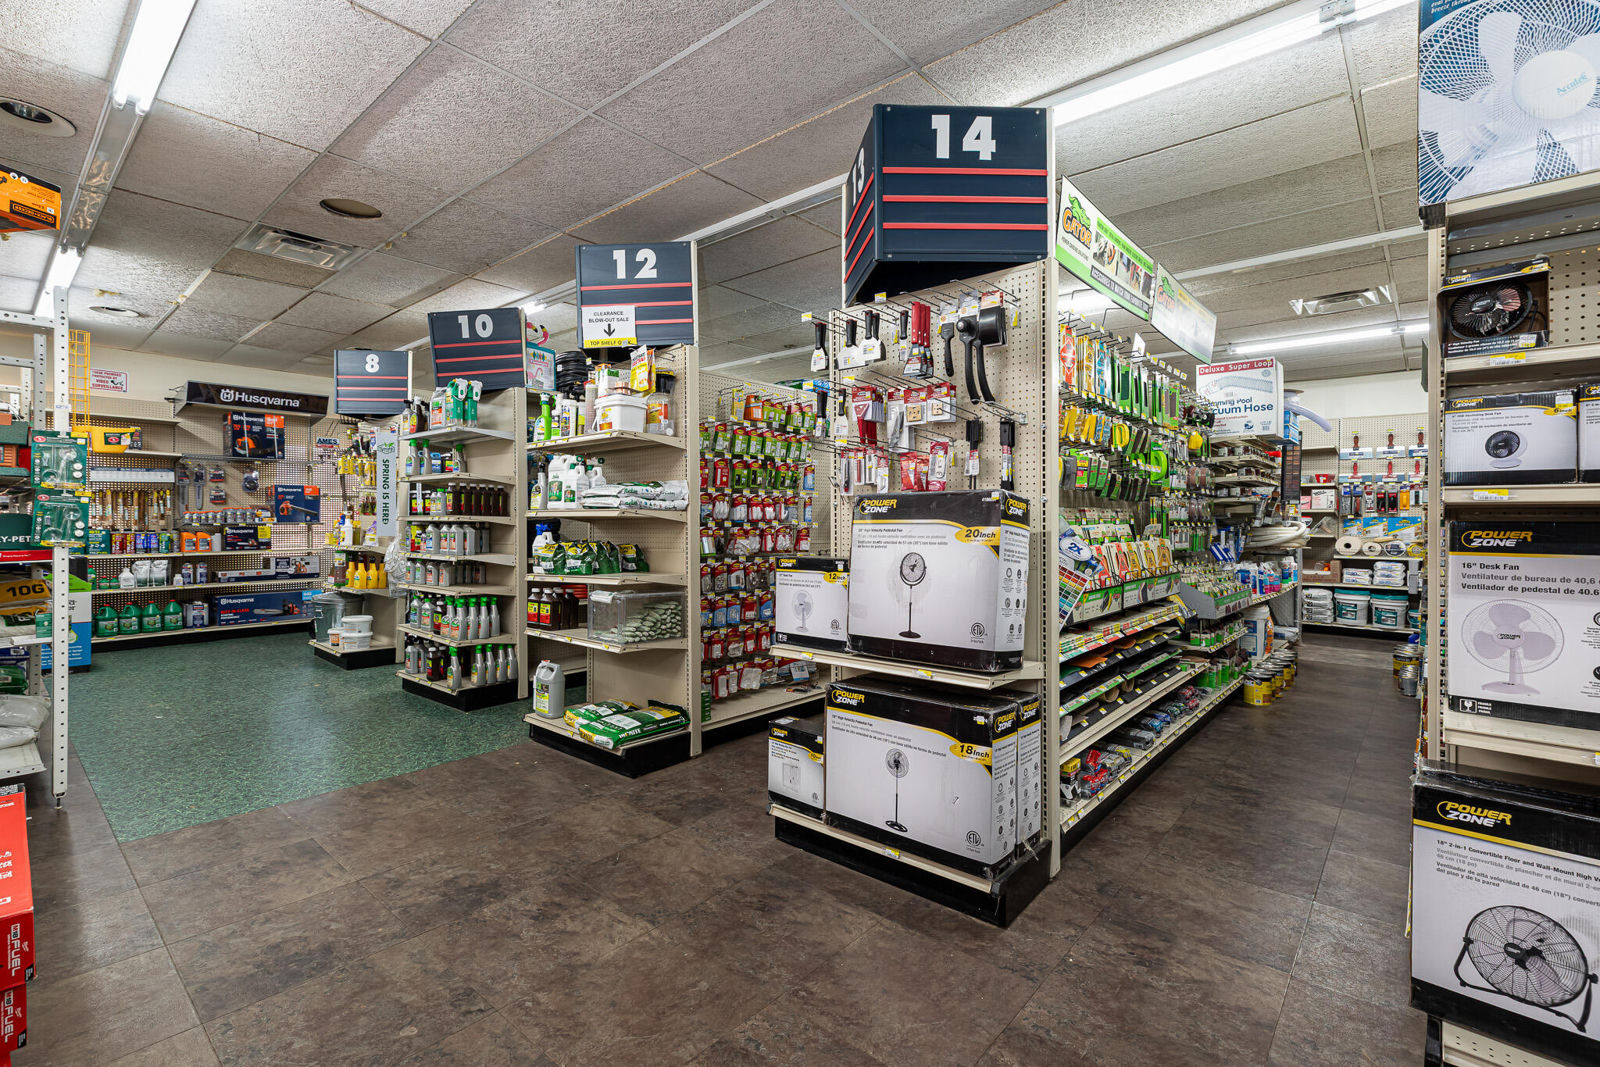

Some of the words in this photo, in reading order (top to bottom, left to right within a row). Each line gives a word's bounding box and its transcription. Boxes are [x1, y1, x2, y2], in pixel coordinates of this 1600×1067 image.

[932, 114, 996, 160] 14
[1063, 207, 1092, 246] GATOR
[613, 248, 657, 279] 12
[458, 314, 494, 338] 10
[365, 354, 379, 373] 8
[1254, 360, 1272, 368] Loop
[235, 392, 300, 407] Husqvarna
[1244, 404, 1273, 412] Hose
[864, 499, 897, 508] POWER
[1008, 499, 1027, 512] POWER
[1009, 506, 1023, 516] ZONE
[1470, 531, 1533, 542] POWER
[1471, 538, 1517, 547] ZONE
[1068, 542, 1083, 554] 2X
[1461, 572, 1508, 581] Ventilateur
[1525, 575, 1557, 583] bureau
[6, 584, 44, 596] 10G
[1461, 583, 1505, 591] Ventilador
[1521, 586, 1561, 594] pedestal
[1578, 588, 1599, 596] 40.6
[836, 690, 865, 703] POWER
[836, 696, 858, 706] ZONE
[997, 712, 1016, 726] POWER
[997, 720, 1012, 731] ZONE
[1446, 801, 1512, 826] POWER
[1447, 810, 1494, 827] ZONE
[1449, 842, 1467, 851] 2-in-1
[1469, 847, 1502, 859] Convertible
[1504, 856, 1520, 864] Floor
[1536, 862, 1575, 876] Wall-Mount
[1576, 872, 1592, 880] High
[1470, 855, 1504, 868] convertible
[1515, 866, 1543, 878] plancher
[1436, 861, 1466, 872] Ventilador
[1467, 868, 1475, 876] de
[1482, 878, 1500, 888] pared
[12, 940, 20, 976] FUEL
[5, 1008, 14, 1043] FUEL
